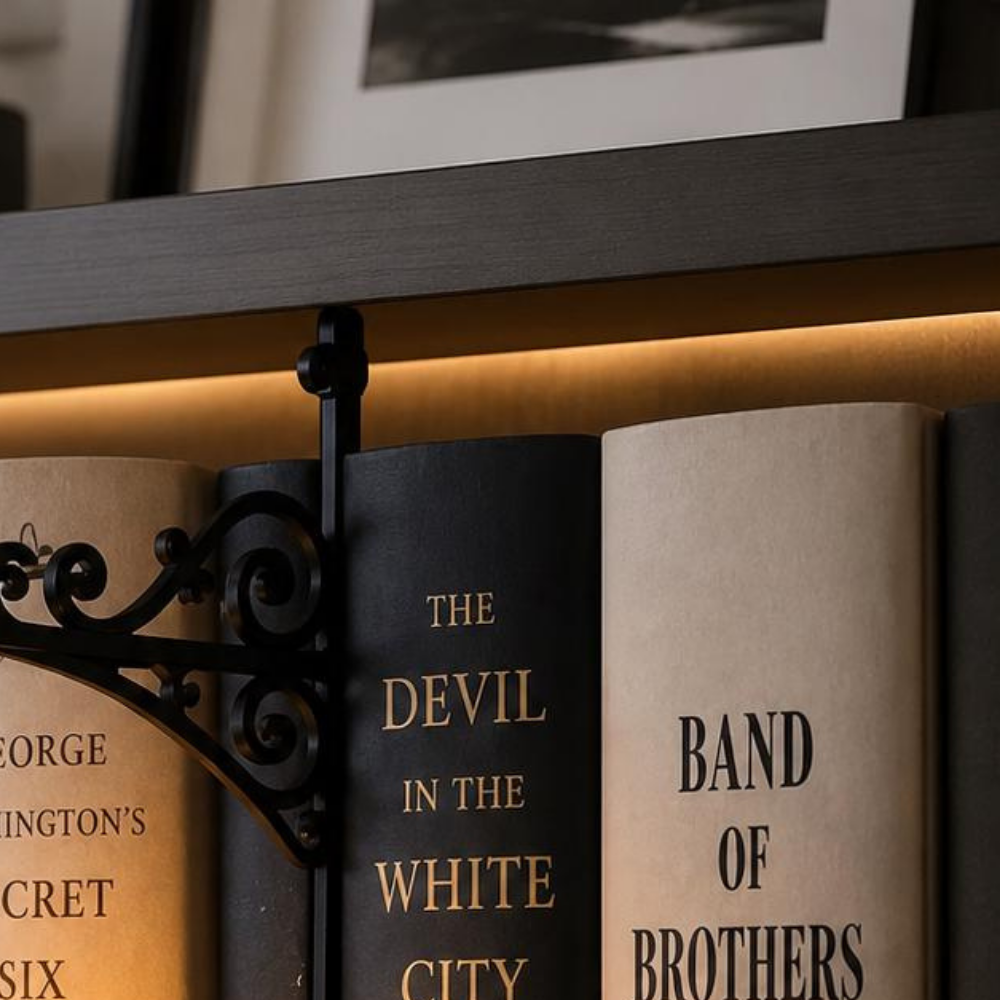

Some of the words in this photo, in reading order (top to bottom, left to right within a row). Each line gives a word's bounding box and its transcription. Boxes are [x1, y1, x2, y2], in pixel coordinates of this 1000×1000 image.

[426, 591, 495, 626] THE
[381, 668, 546, 730] DEVIL
[678, 709, 814, 792] BAND
[403, 779, 437, 812] IN
[452, 774, 525, 810] THE
[374, 855, 555, 912] WHITE
[717, 824, 769, 890] OF
